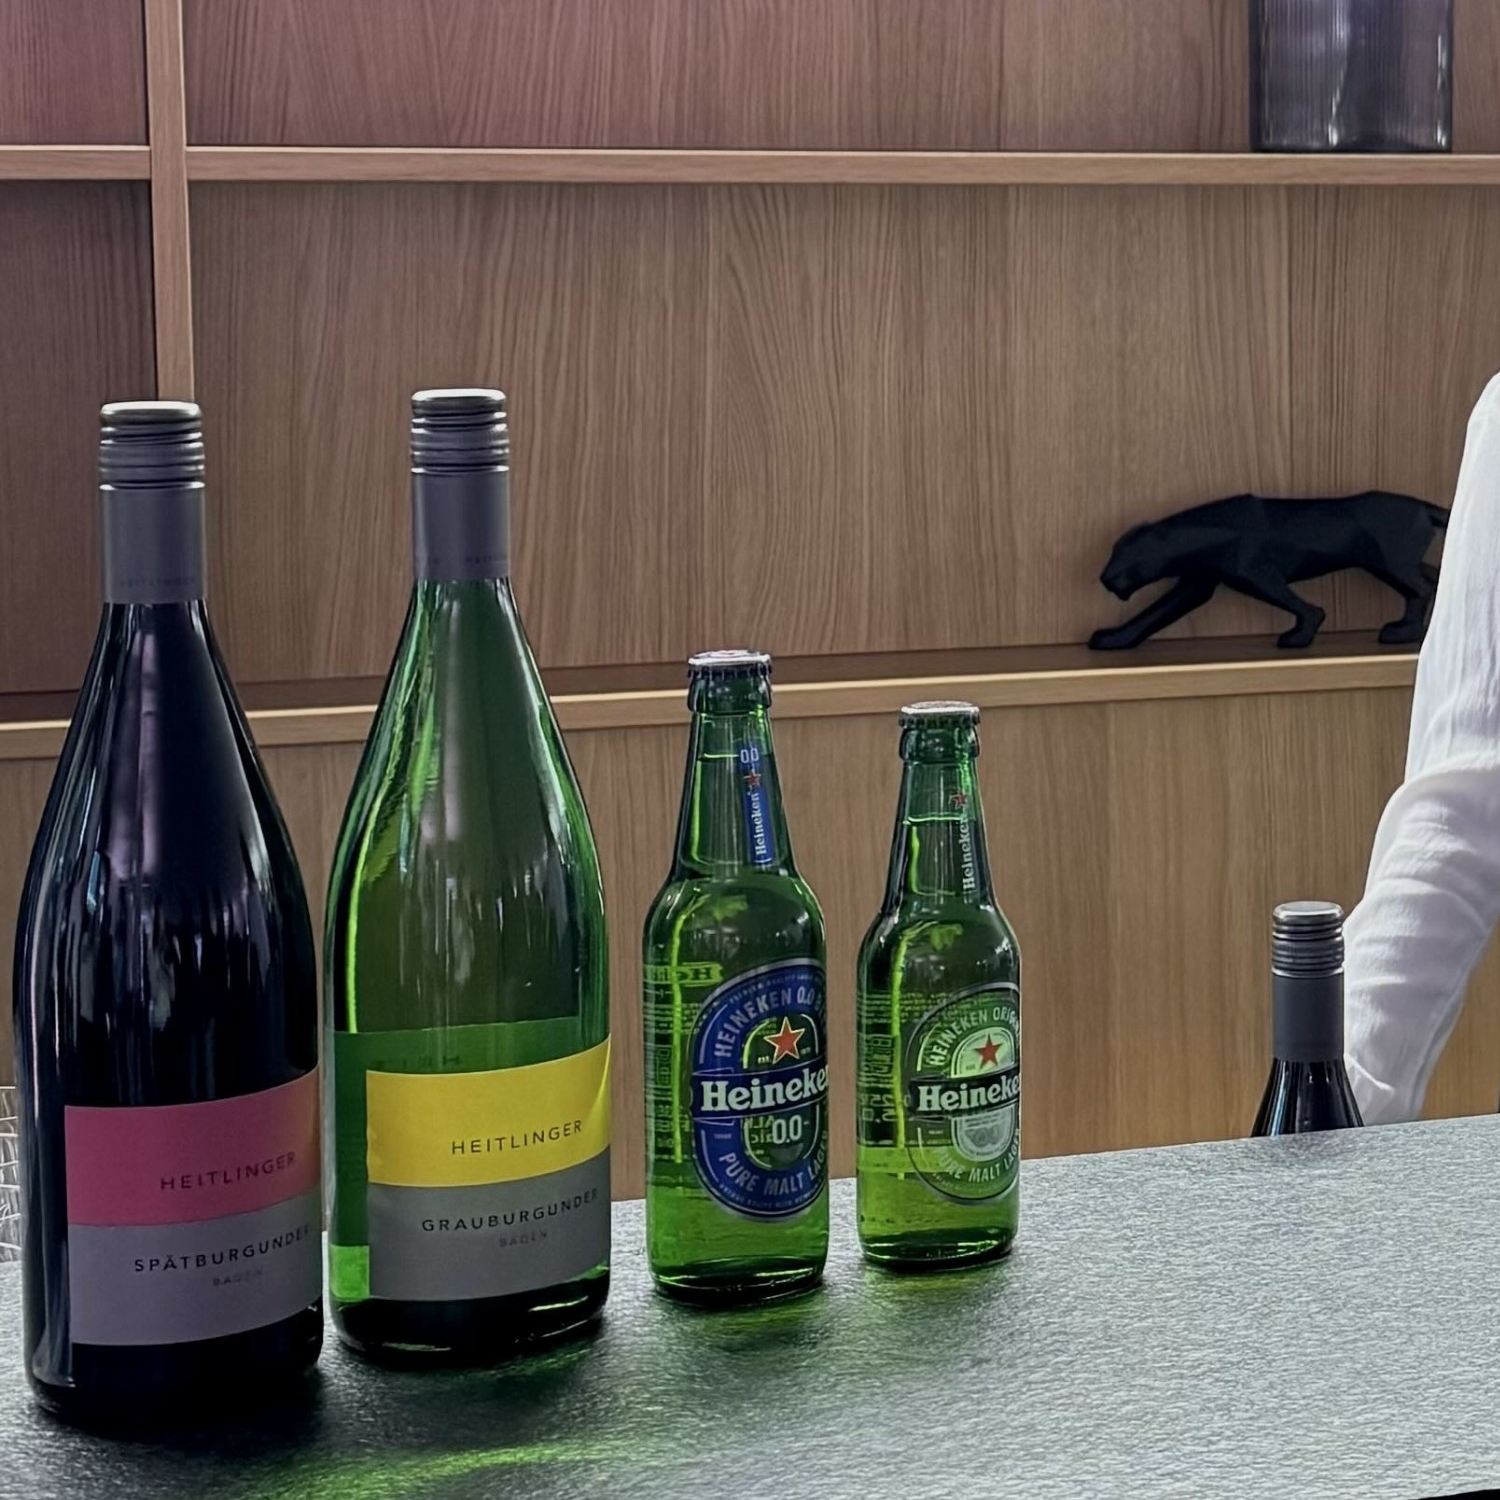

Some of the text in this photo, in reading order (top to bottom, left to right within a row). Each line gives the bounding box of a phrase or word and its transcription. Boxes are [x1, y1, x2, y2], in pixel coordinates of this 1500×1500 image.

[751, 792, 767, 856] Heineken
[713, 987, 792, 1058] HEINEKEN
[928, 1009, 988, 1067] HEINEKEN
[700, 1063, 829, 1112] Heineke
[917, 1075, 1020, 1112] Heineke
[452, 1119, 583, 1155] HEITLINGER
[772, 1114, 802, 1145] 0.0
[160, 1151, 297, 1190] HEITLINGER
[718, 1152, 760, 1192] PURE
[764, 1172, 805, 1196] MALT
[968, 1163, 1001, 1183] MALT
[421, 1187, 599, 1232] GRAUBURGUNDER
